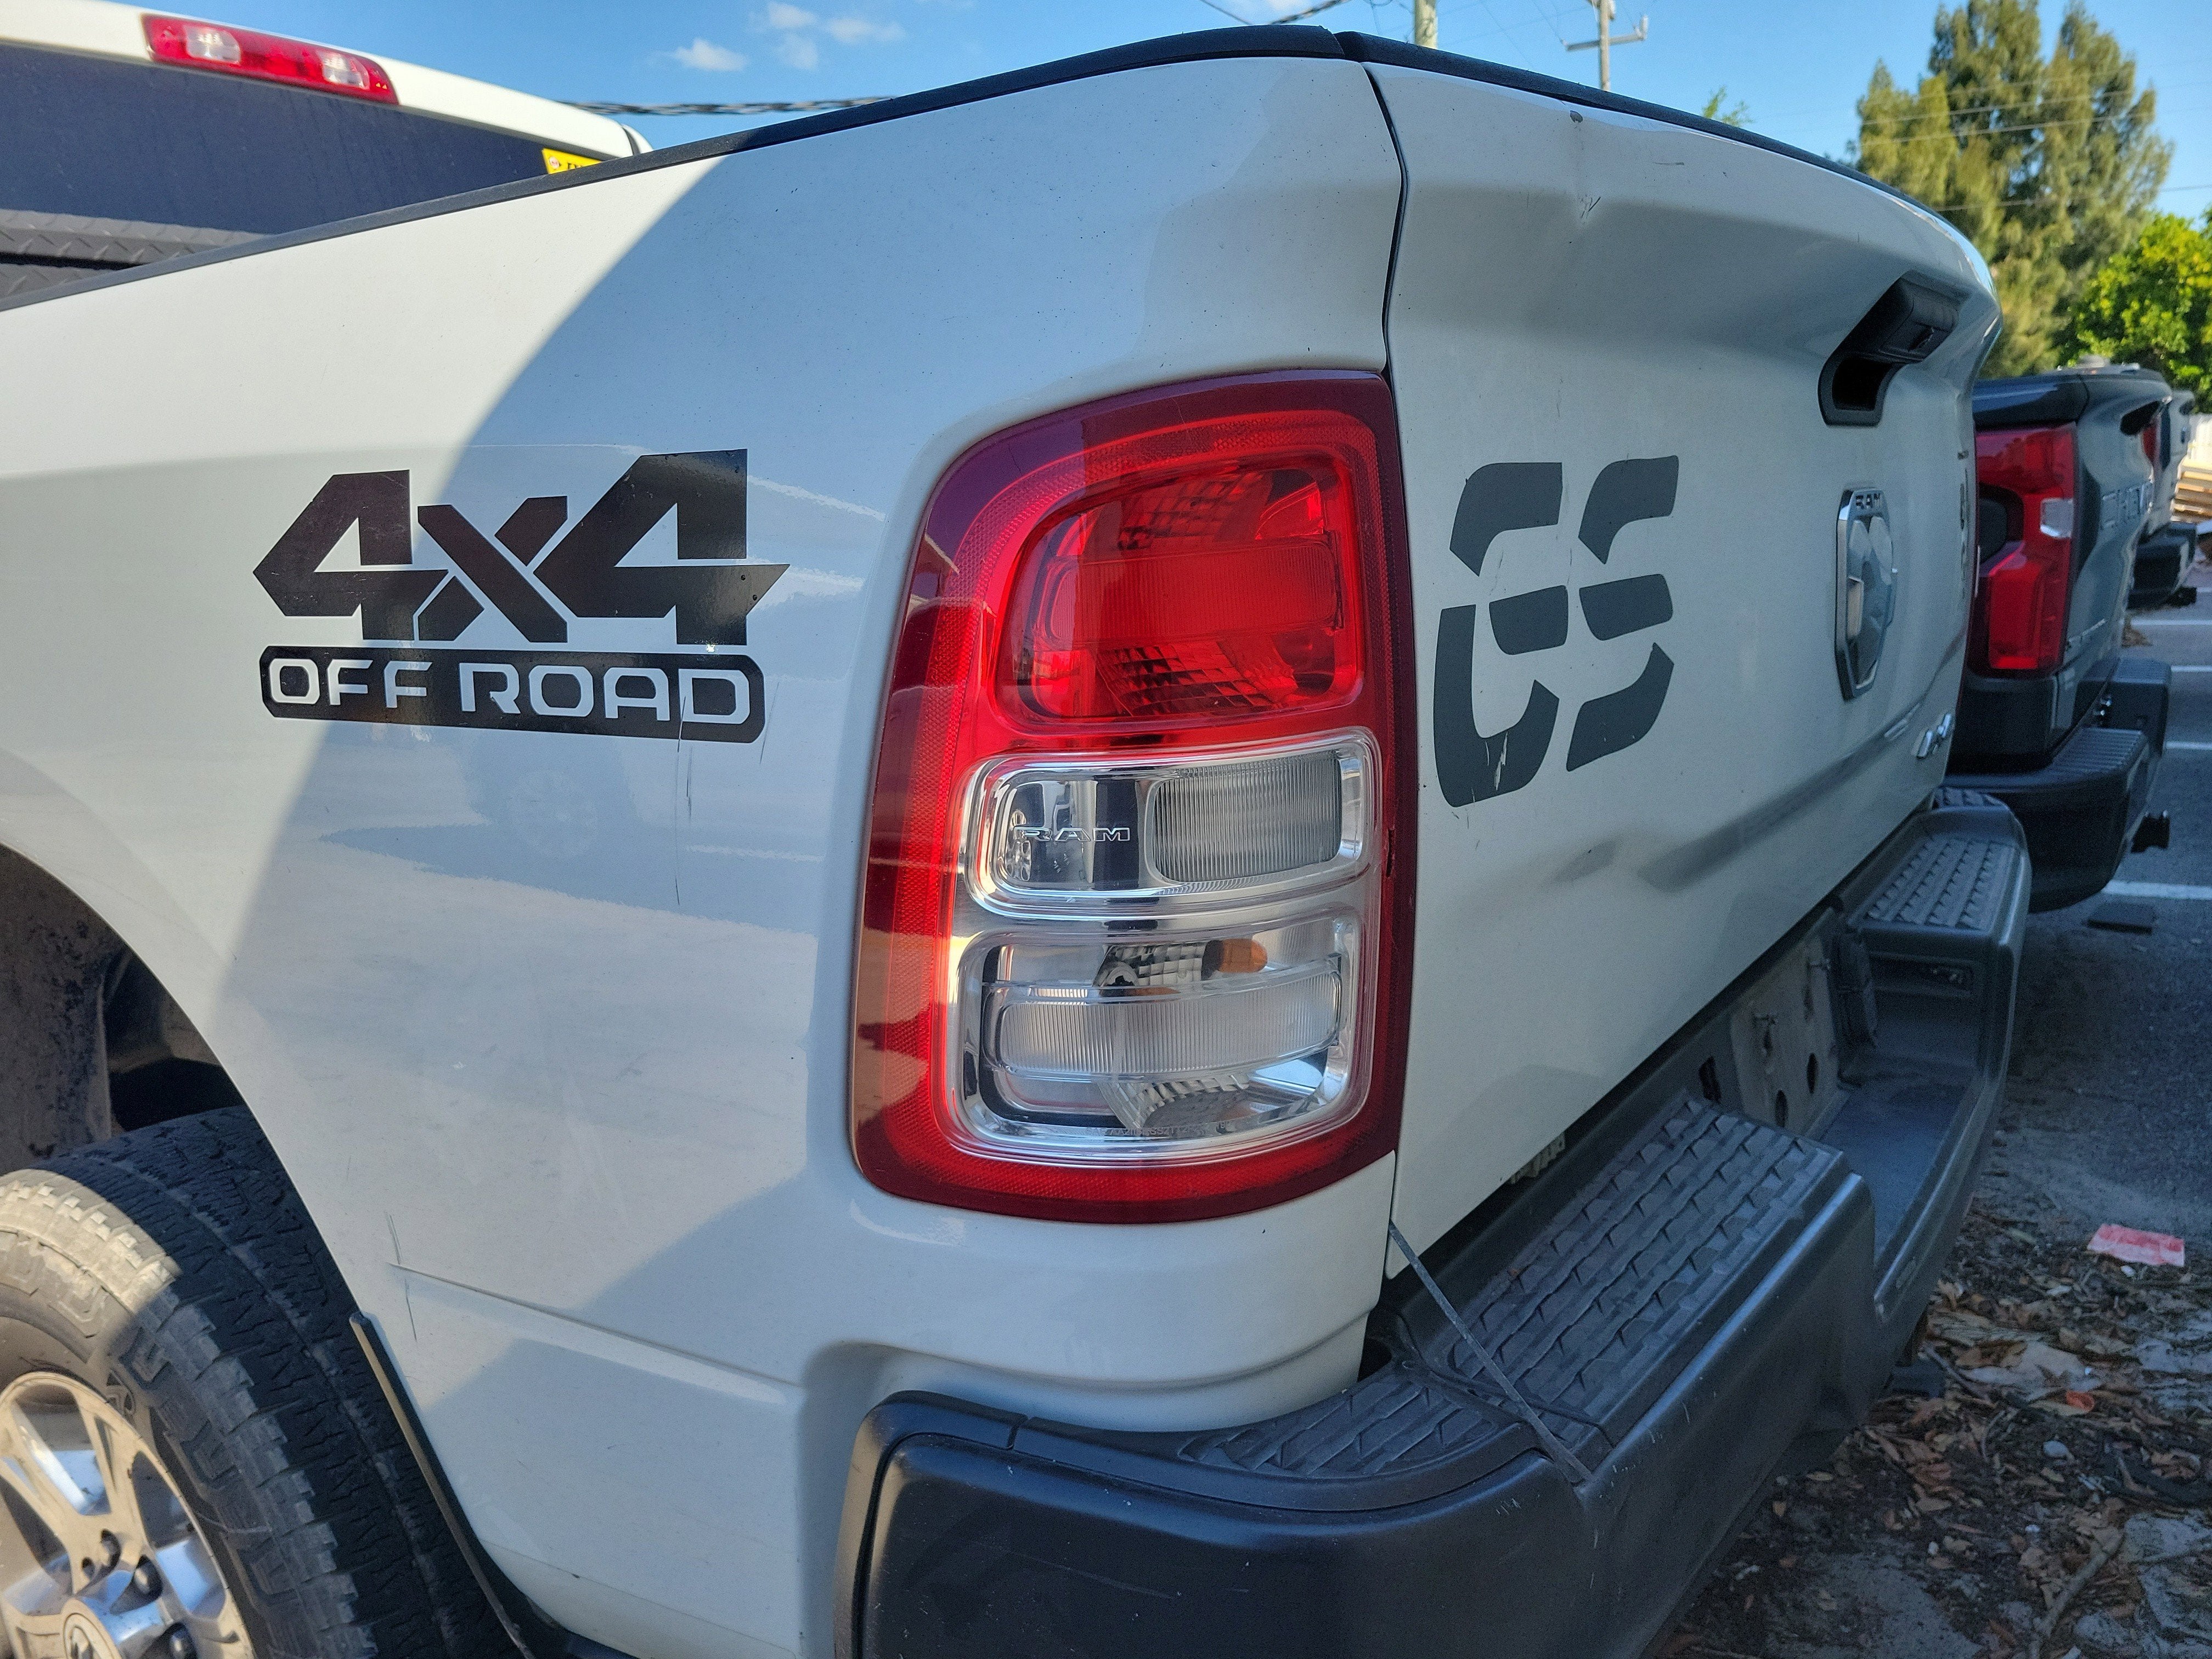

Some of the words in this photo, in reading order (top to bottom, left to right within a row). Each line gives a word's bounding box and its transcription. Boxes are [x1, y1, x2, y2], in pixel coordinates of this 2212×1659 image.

[269, 658, 433, 709] OFF
[459, 662, 751, 725] ROAD
[1014, 827, 1131, 842] RAM
